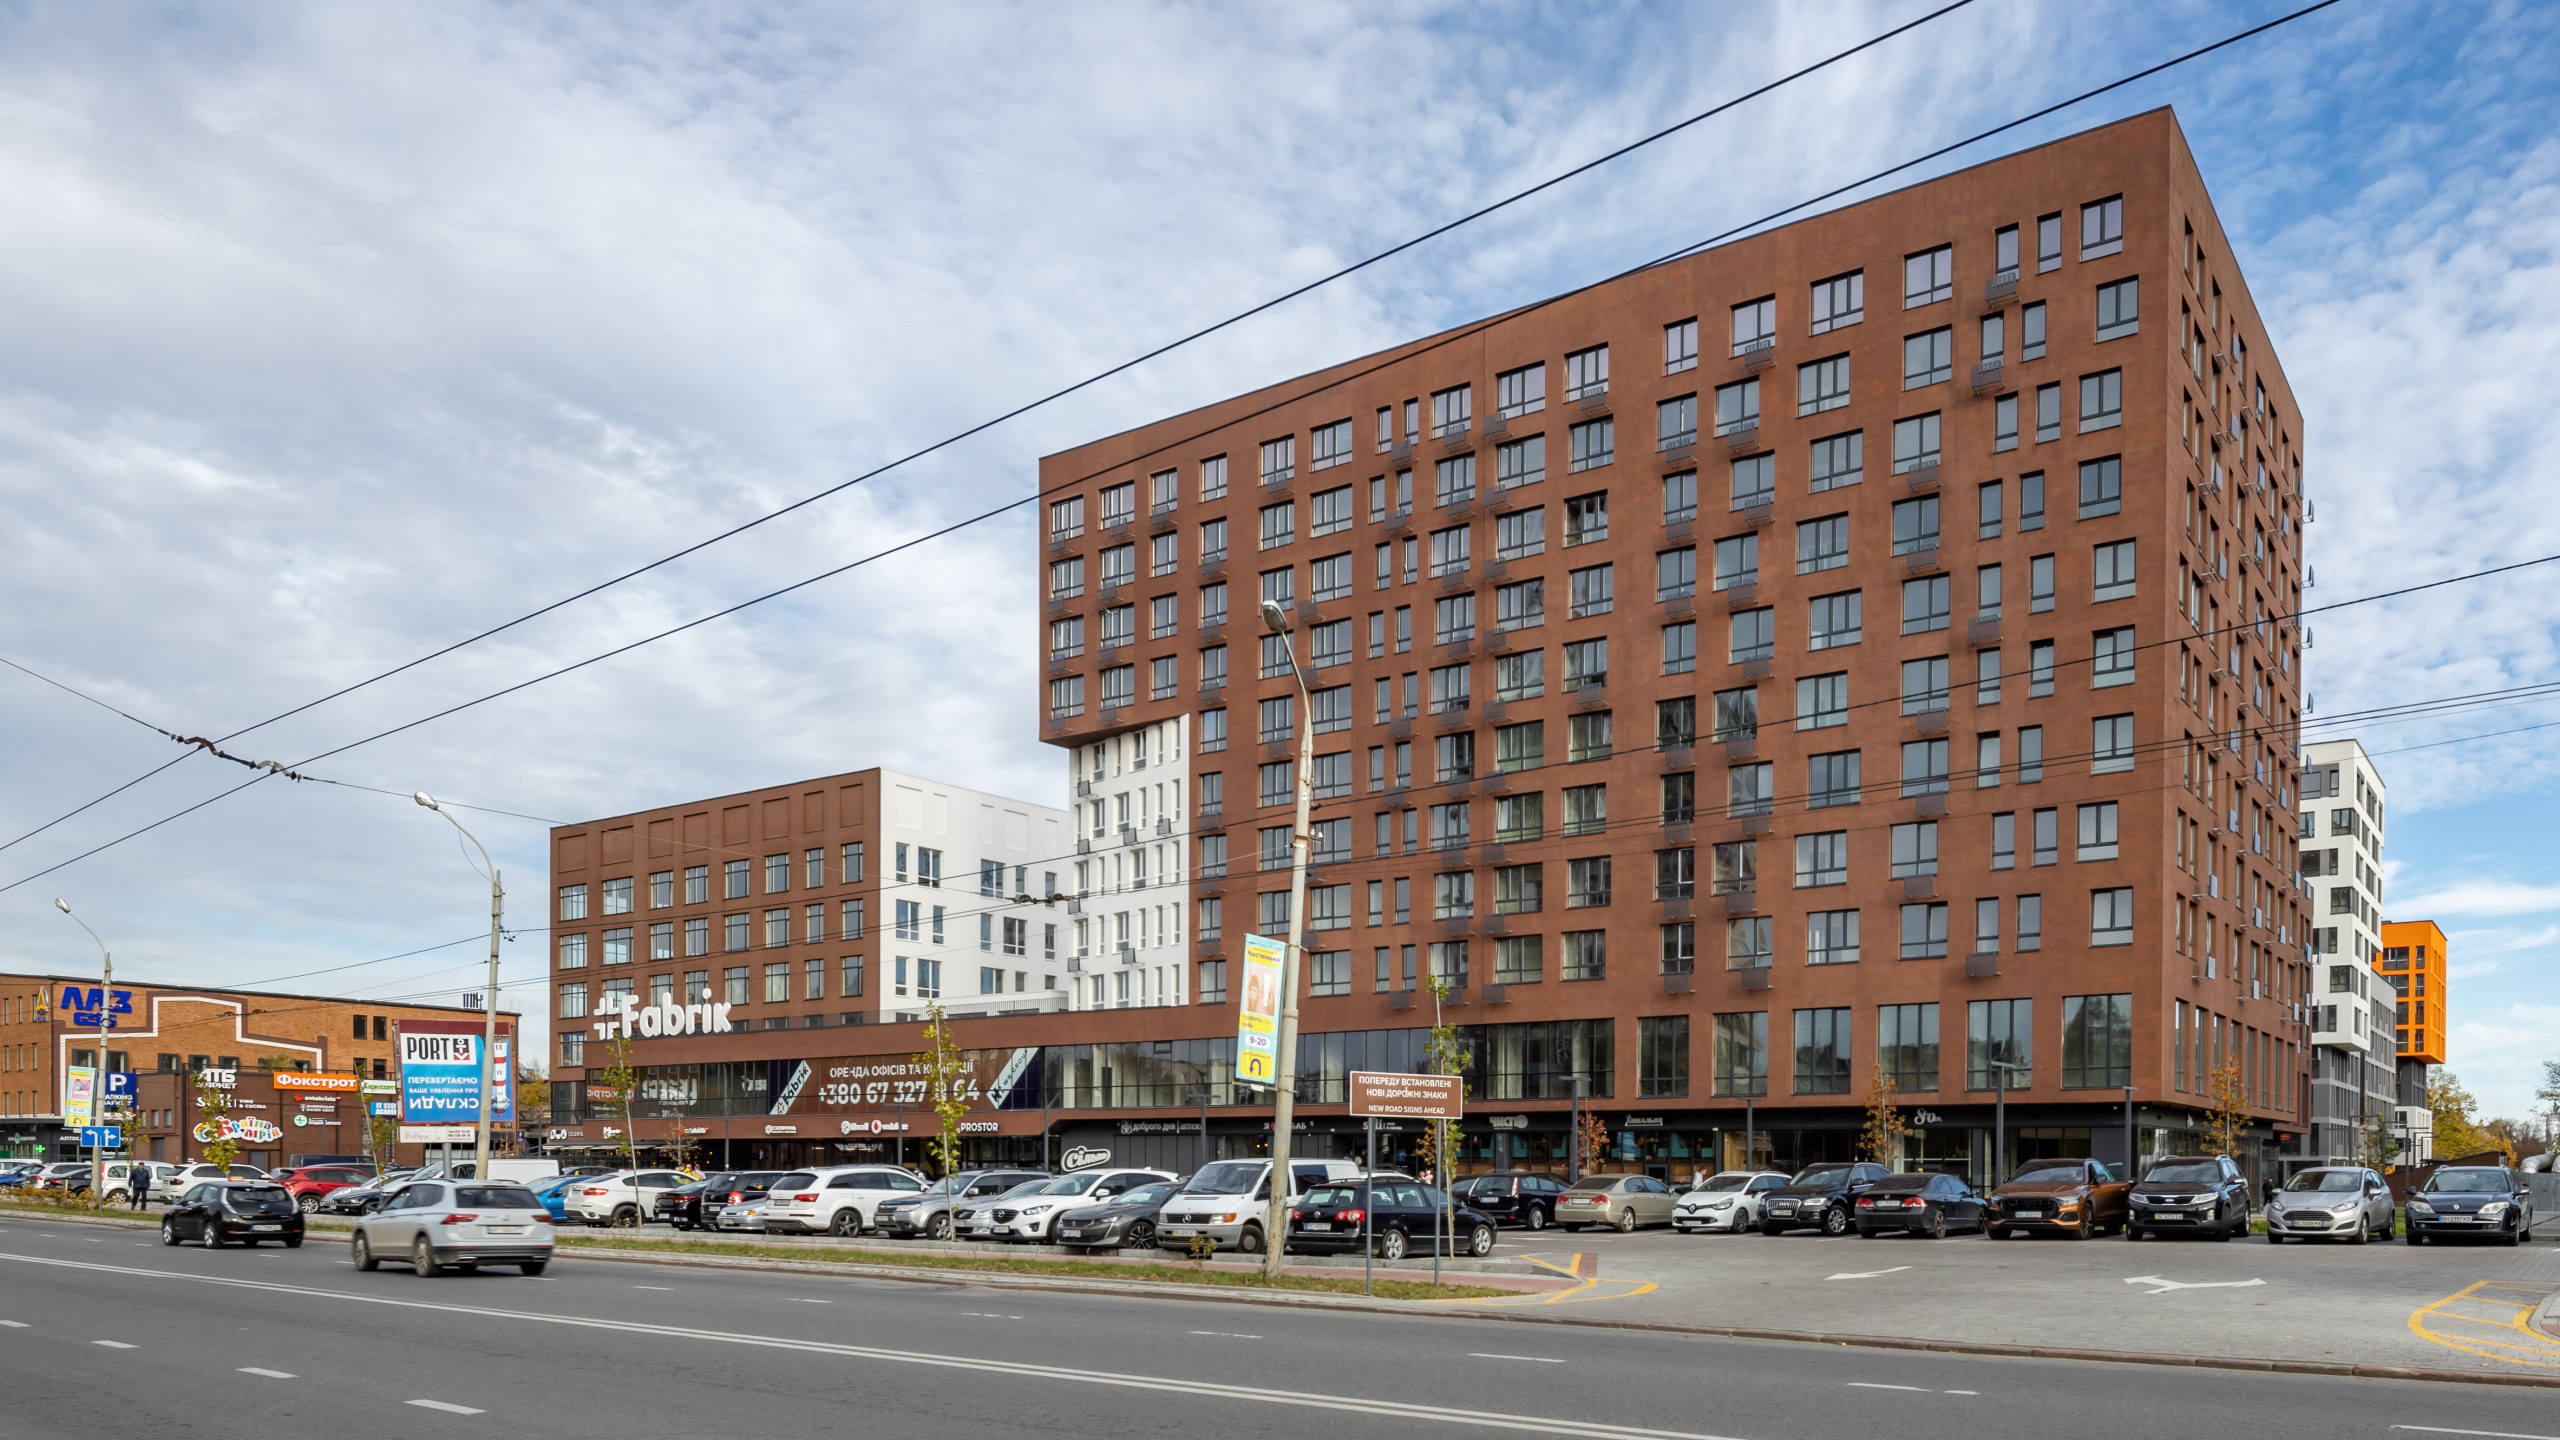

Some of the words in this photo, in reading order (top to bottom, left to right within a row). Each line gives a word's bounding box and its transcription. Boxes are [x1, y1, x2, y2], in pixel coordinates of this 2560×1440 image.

[1250, 1036, 1267, 1046] 9-20
[829, 1067, 870, 1078] ОРЕНДА
[871, 1064, 906, 1076] ОФІСІВ
[277, 1074, 356, 1088] Фокстрот
[1358, 1076, 1400, 1086] ПОПЕРЕДУ
[1401, 1078, 1452, 1088] ВСТАНОВЛЕНІ
[866, 1082, 889, 1103] 67
[893, 1081, 928, 1103] 327
[1366, 1088, 1385, 1097] НОВІ
[1386, 1089, 1421, 1099] ДОРОЖНІ
[1423, 1091, 1447, 1099] ЗНАКИ
[409, 1096, 480, 1109] СКЛАДИ
[1385, 1105, 1402, 1113] ROAD
[1403, 1106, 1422, 1114] SIGNS
[1424, 1106, 1445, 1114] AHEAD
[960, 1122, 998, 1132] PROSTOR
